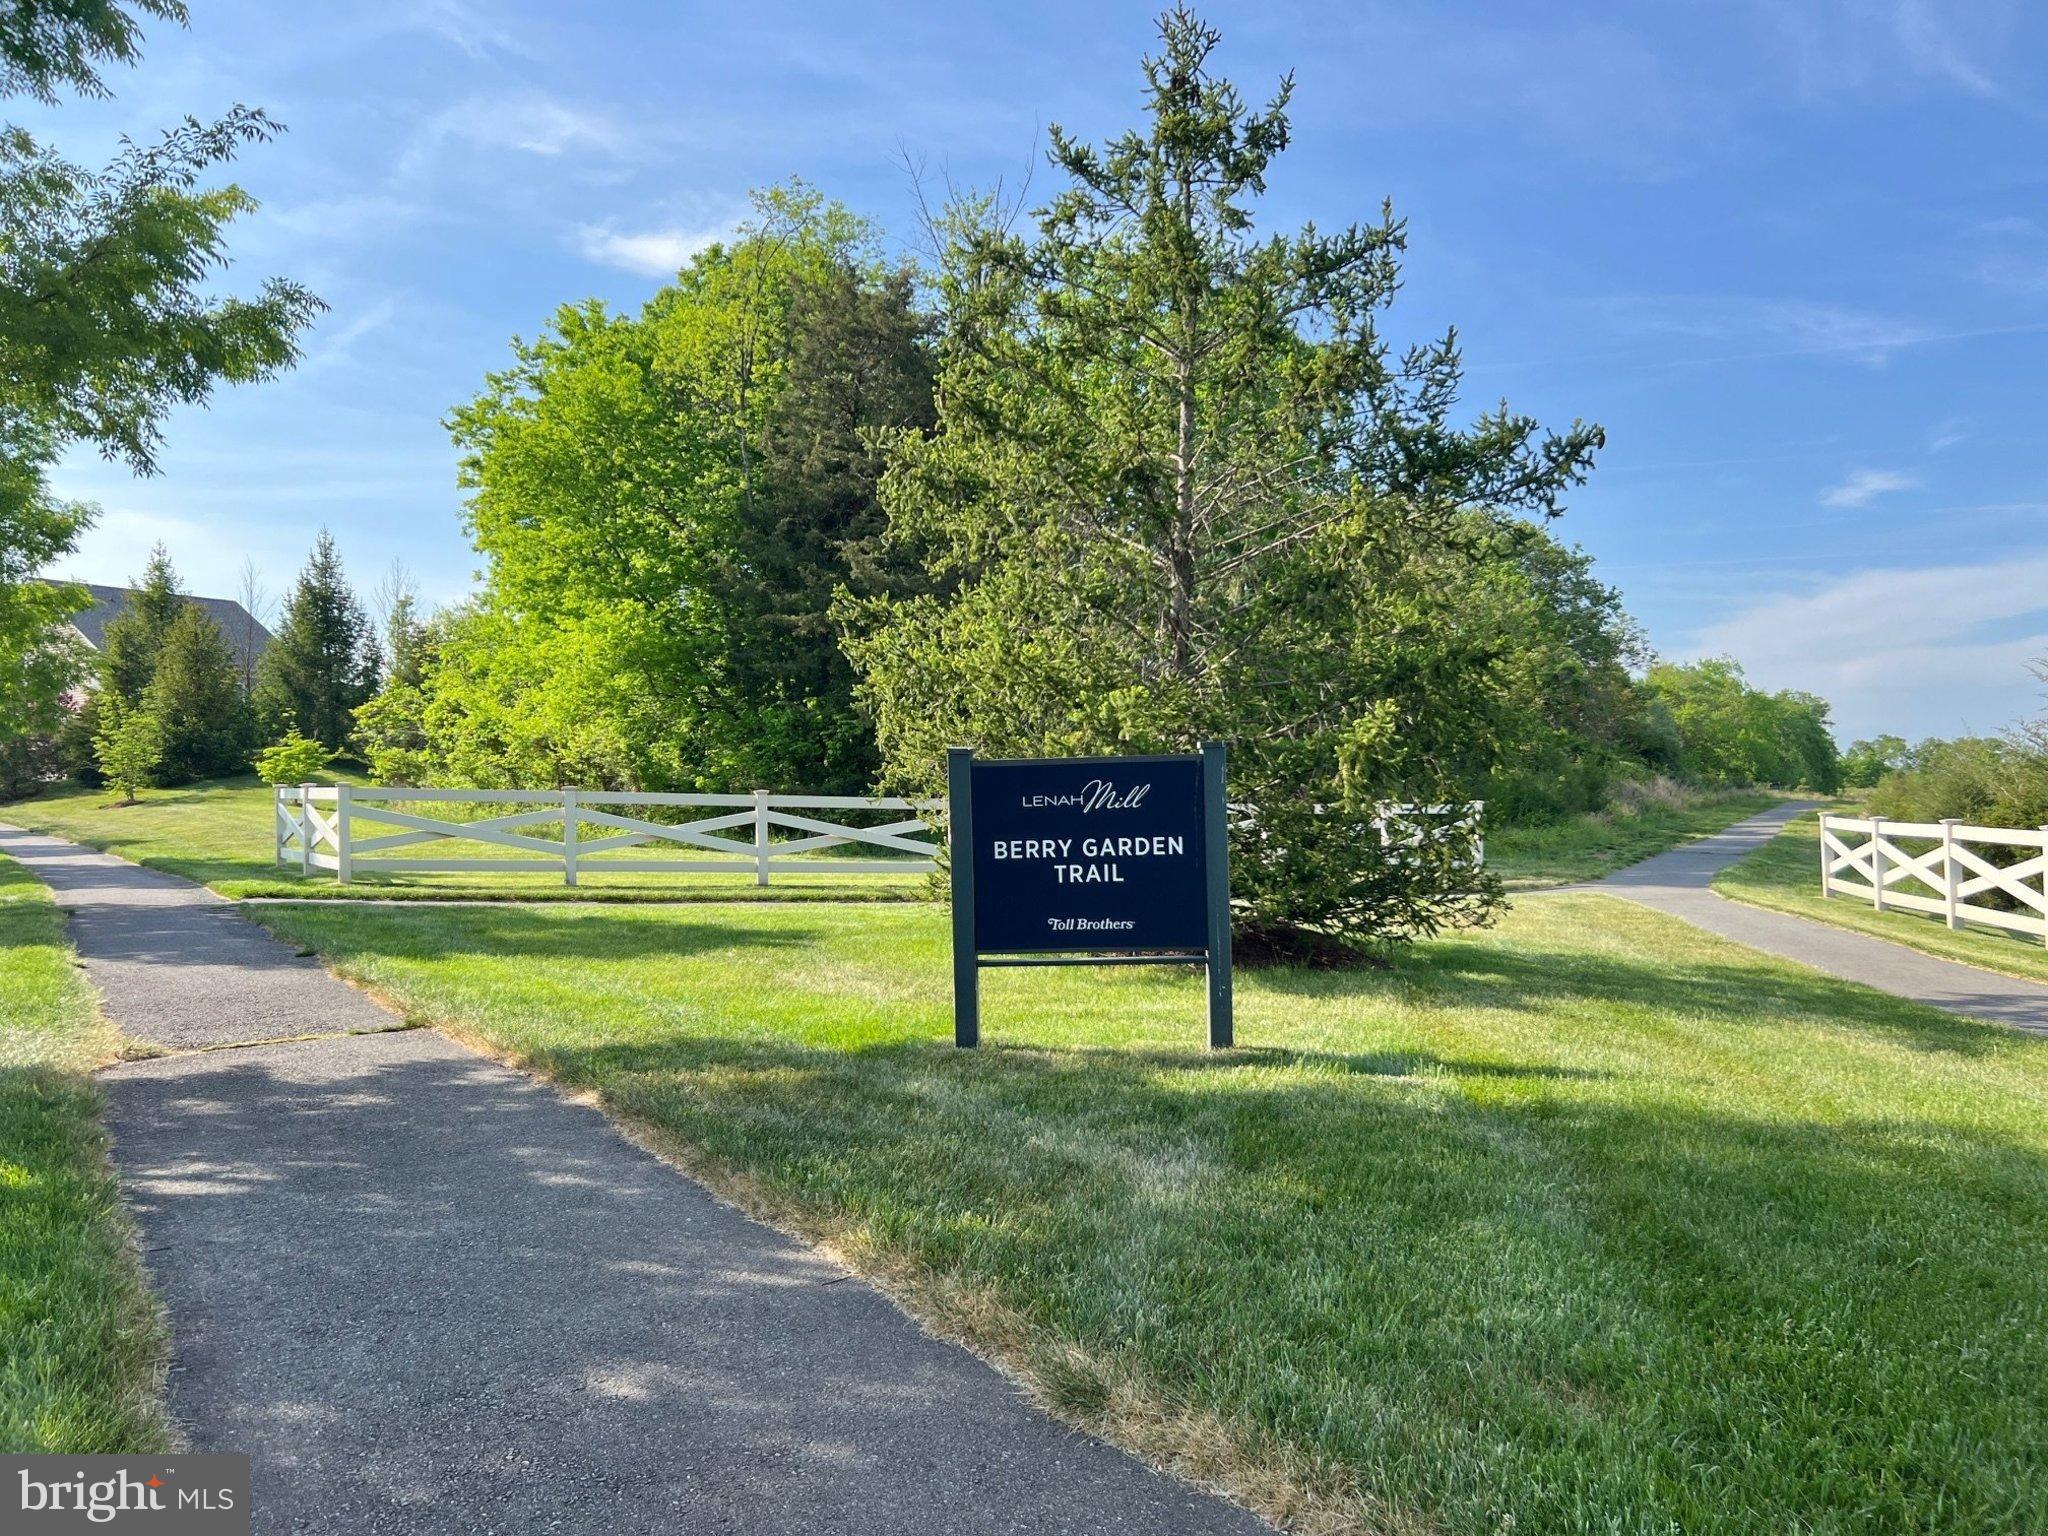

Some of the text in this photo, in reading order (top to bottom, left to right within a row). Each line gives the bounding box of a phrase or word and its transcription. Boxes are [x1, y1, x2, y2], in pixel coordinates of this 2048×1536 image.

[1022, 779, 1151, 814] LENAH Mill
[993, 836, 1185, 860] BERRY GARDEN
[1054, 864, 1125, 884] TRAIL
[1047, 918, 1134, 931] Toll Brothers
